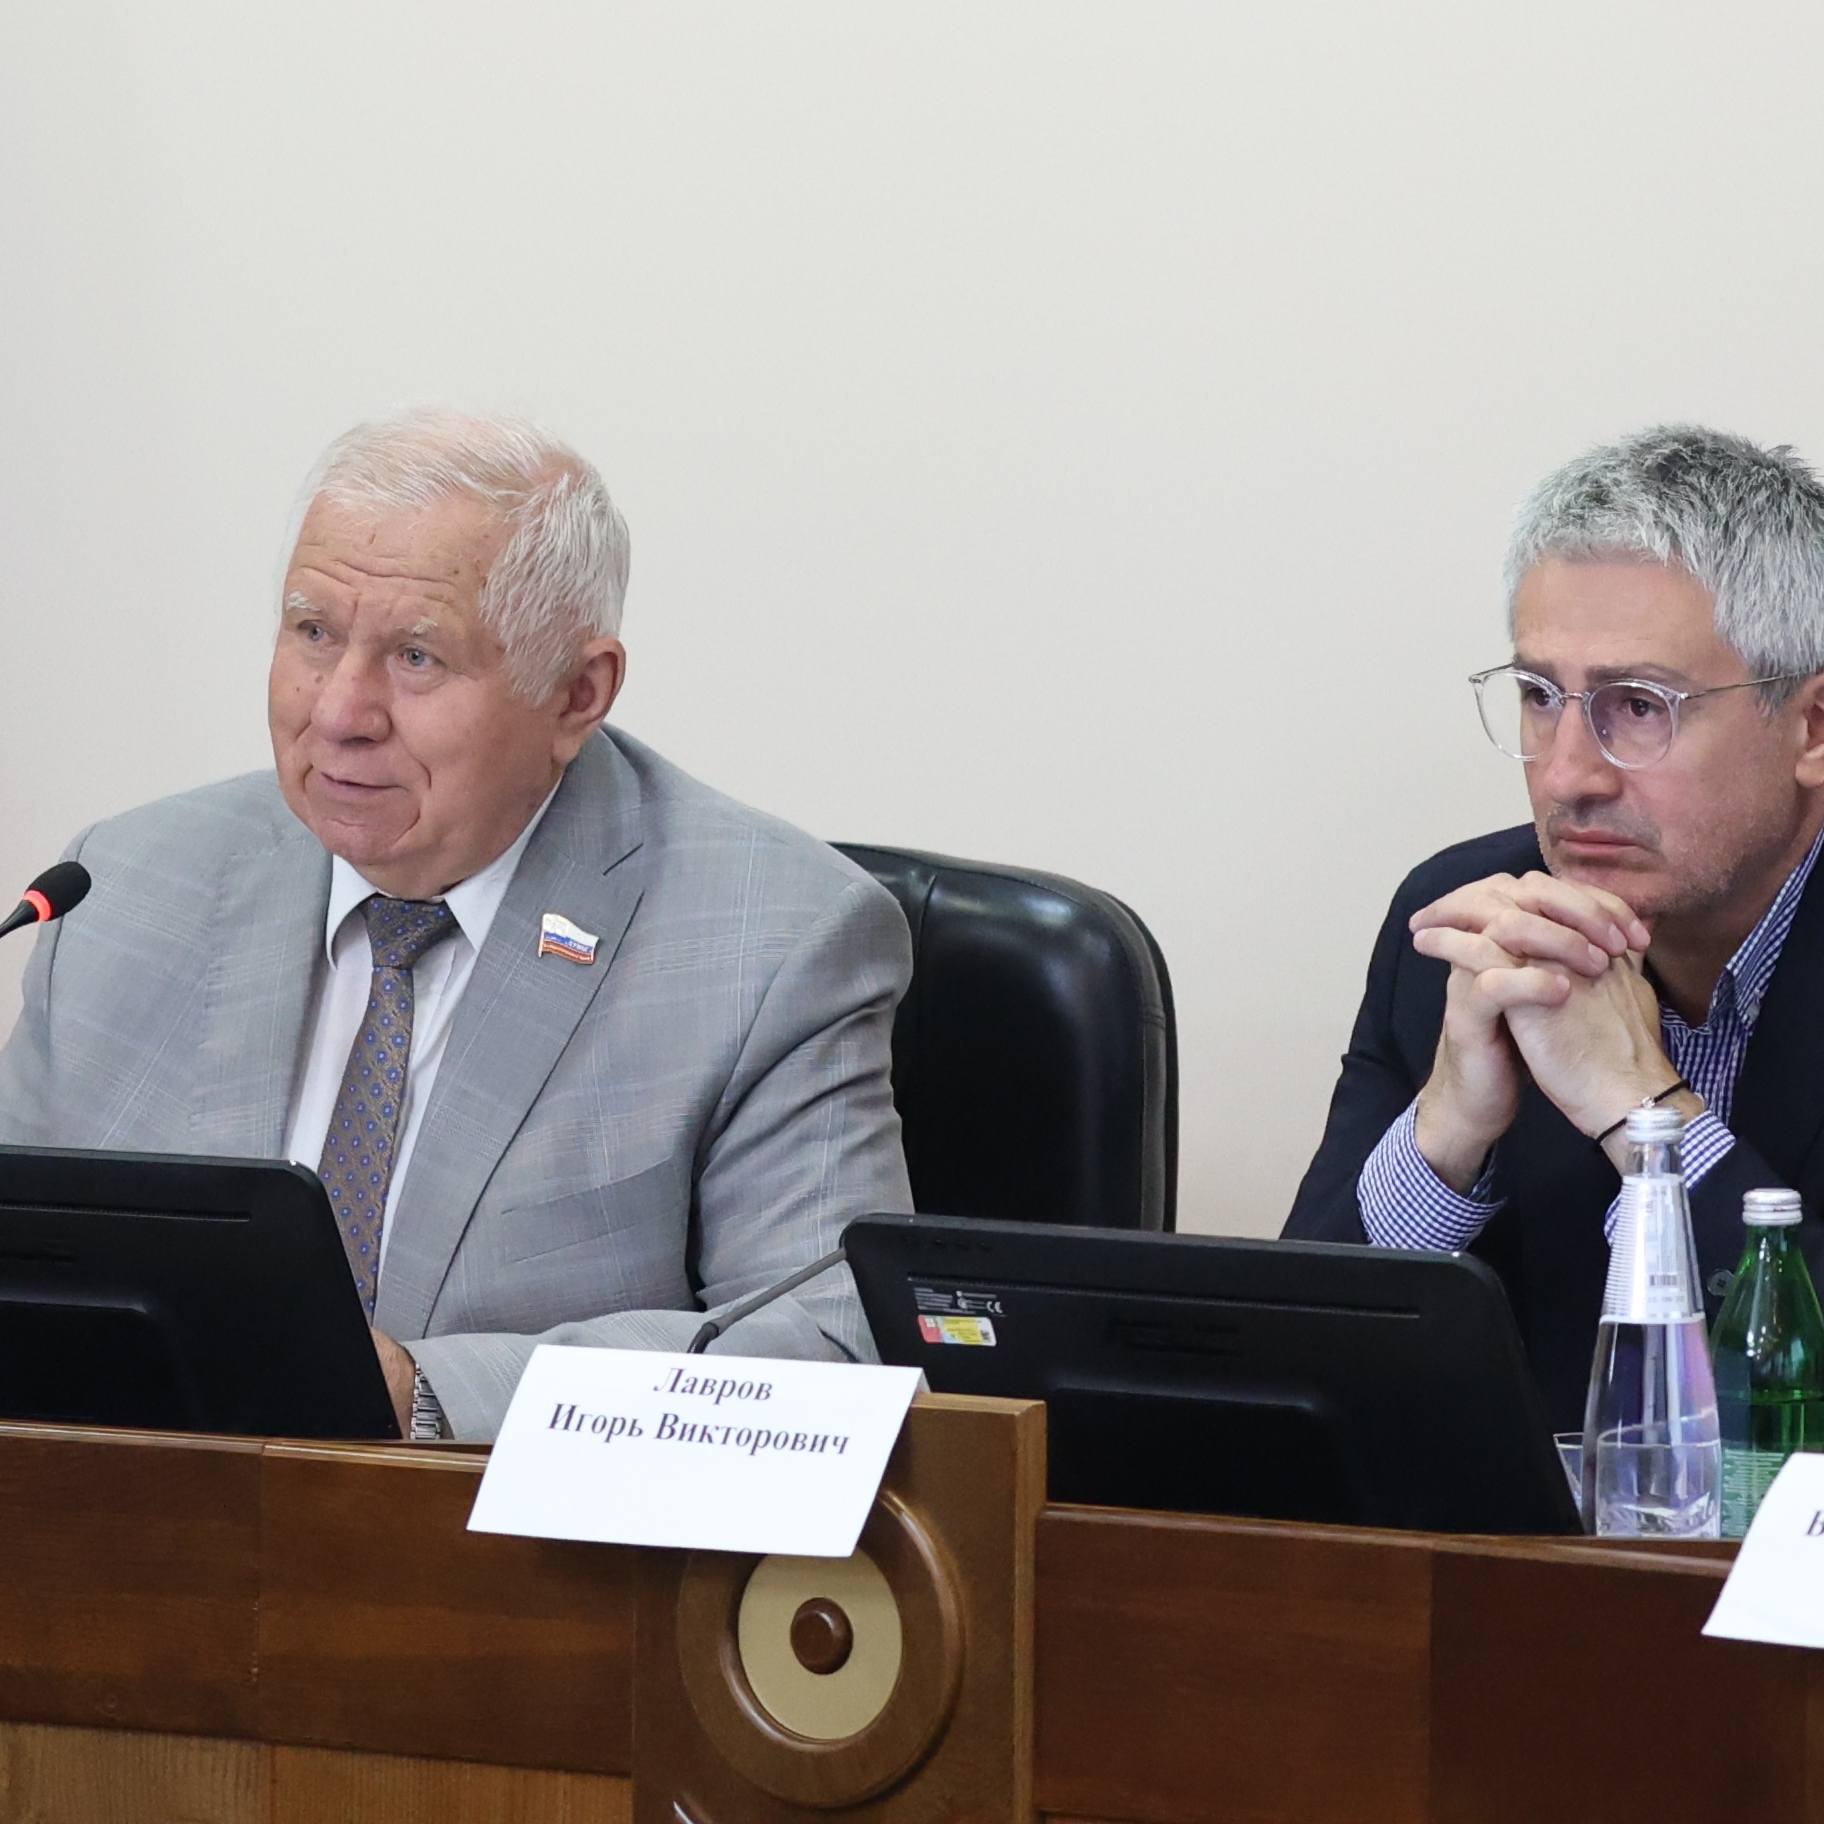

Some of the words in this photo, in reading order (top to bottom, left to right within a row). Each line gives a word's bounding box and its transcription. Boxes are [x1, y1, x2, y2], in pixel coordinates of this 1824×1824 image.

[654, 1367, 773, 1405] Лавров
[547, 1402, 644, 1443] Игорь
[655, 1412, 850, 1456] Викторович
